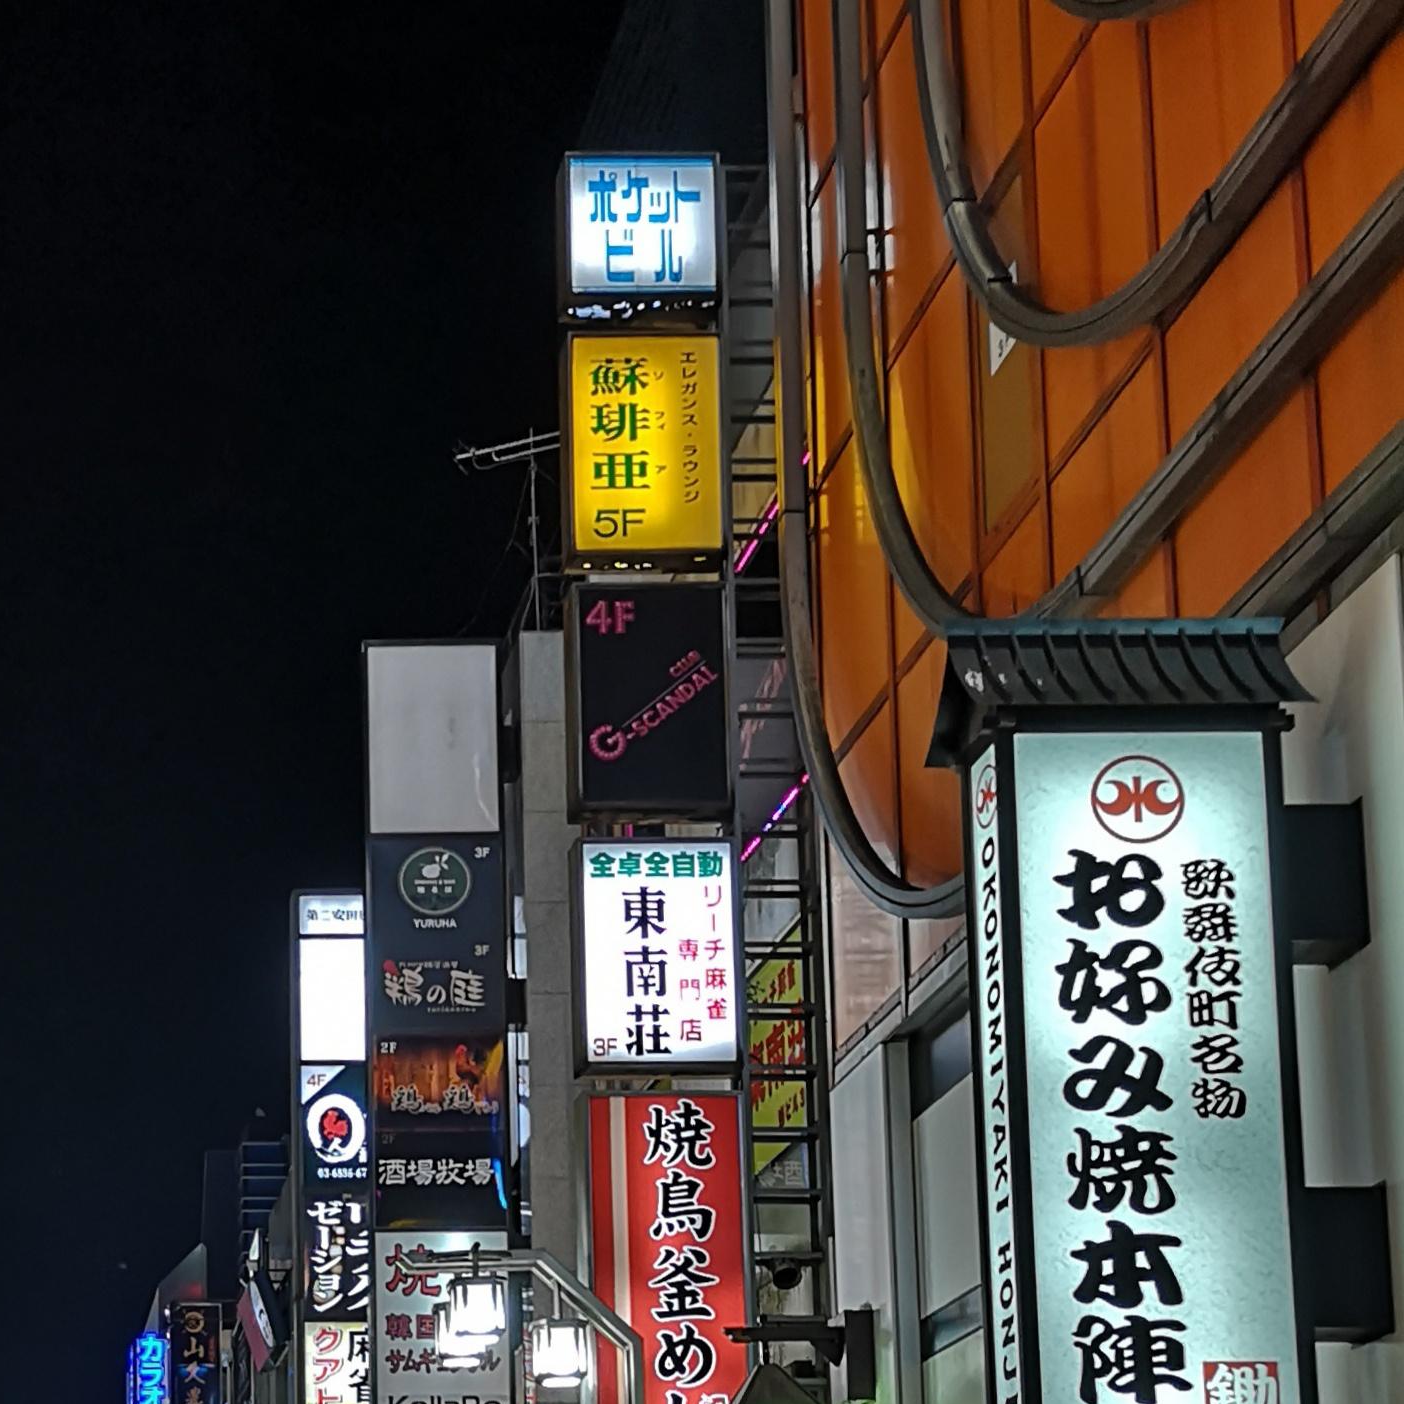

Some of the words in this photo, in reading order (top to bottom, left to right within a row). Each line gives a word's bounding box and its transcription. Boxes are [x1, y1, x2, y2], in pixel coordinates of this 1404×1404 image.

[587, 170, 700, 224] ポケット
[603, 229, 683, 284] ビル
[592, 508, 646, 538] 5F
[585, 601, 636, 634] 4F
[475, 847, 490, 858] 3F
[589, 851, 724, 880] 全卓全自動
[413, 918, 457, 929] YURUHA
[474, 945, 490, 956] 3F
[702, 885, 728, 1021] リーチ麻雀
[622, 886, 671, 1057] 東南荘
[677, 937, 703, 1045] 専門店
[1179, 858, 1248, 1121] 歌舞伎町名物
[977, 836, 1010, 1215] OKONOMIYAKI
[380, 1041, 397, 1054] 2F
[592, 1037, 618, 1057] 3F
[307, 1074, 326, 1087] 4F
[378, 1158, 494, 1185] 酒場牧場
